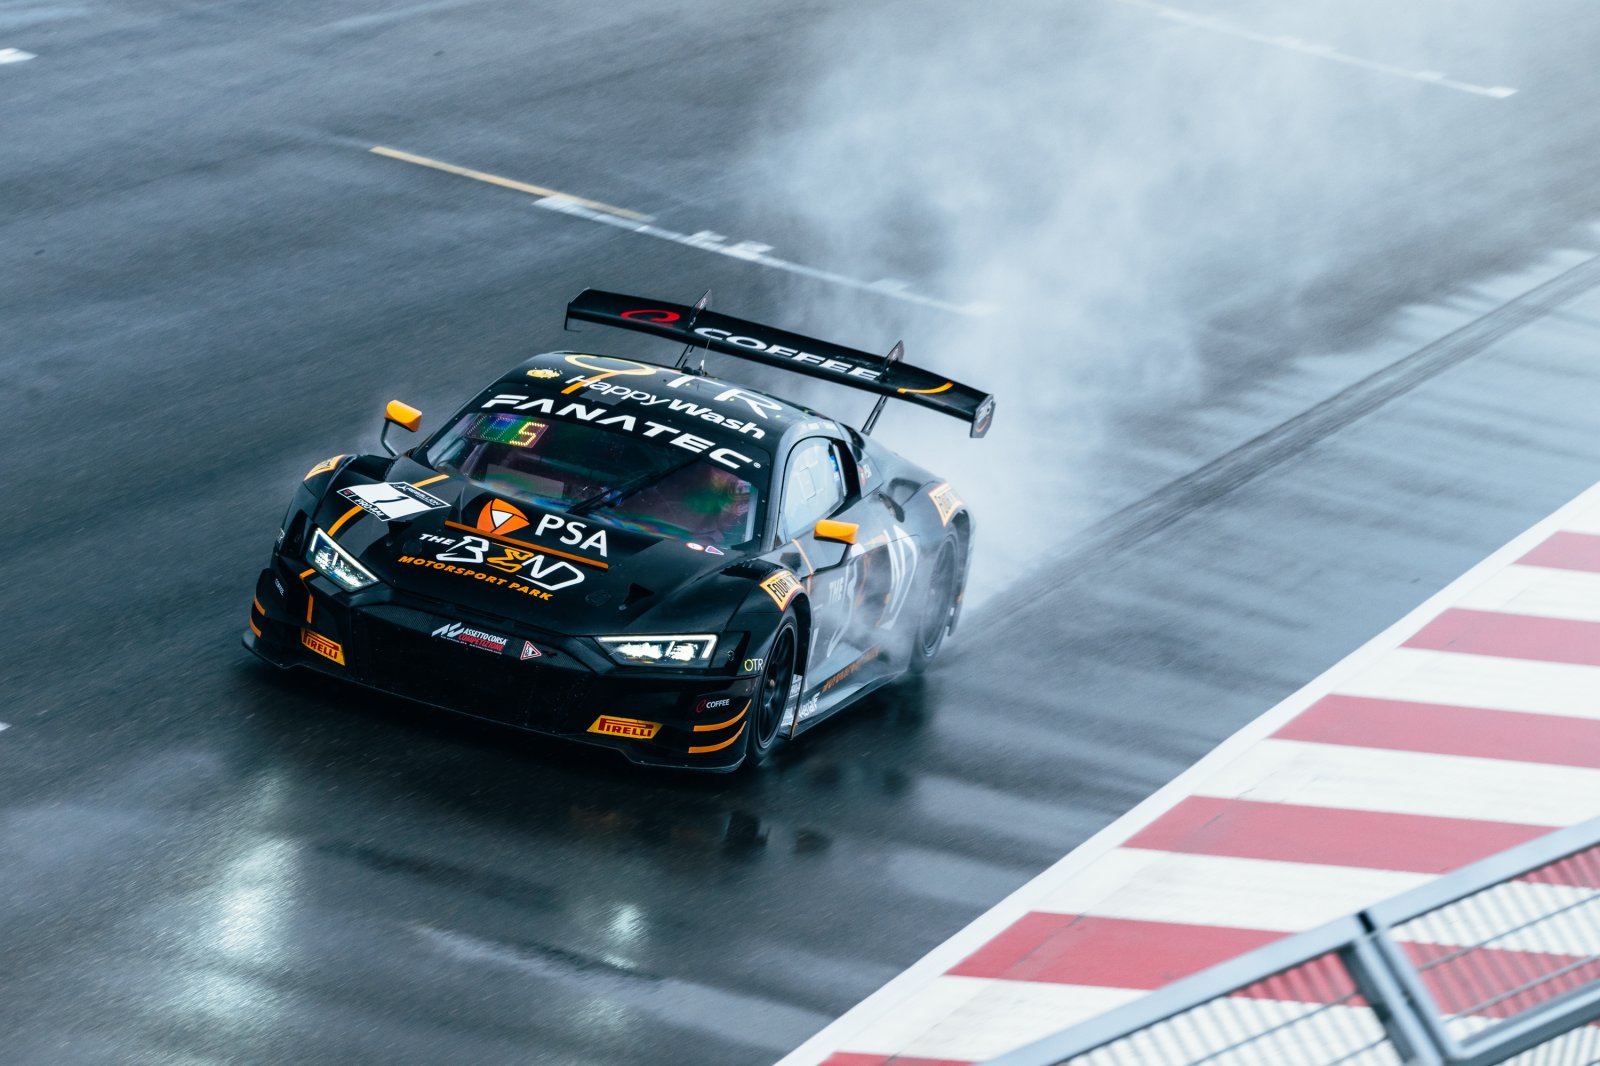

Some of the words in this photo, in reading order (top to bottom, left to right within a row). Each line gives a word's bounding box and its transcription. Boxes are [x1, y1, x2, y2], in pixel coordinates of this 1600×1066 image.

[694, 327, 882, 380] COFFEE
[418, 533, 456, 546] THE
[534, 513, 608, 558] PSA
[397, 555, 508, 586] MOTORSPORT
[508, 581, 555, 601] PARK
[303, 629, 340, 660] PIRELLI
[744, 658, 764, 672] OTR
[706, 698, 730, 709] COFFEE
[598, 717, 655, 738] PIRELLI
